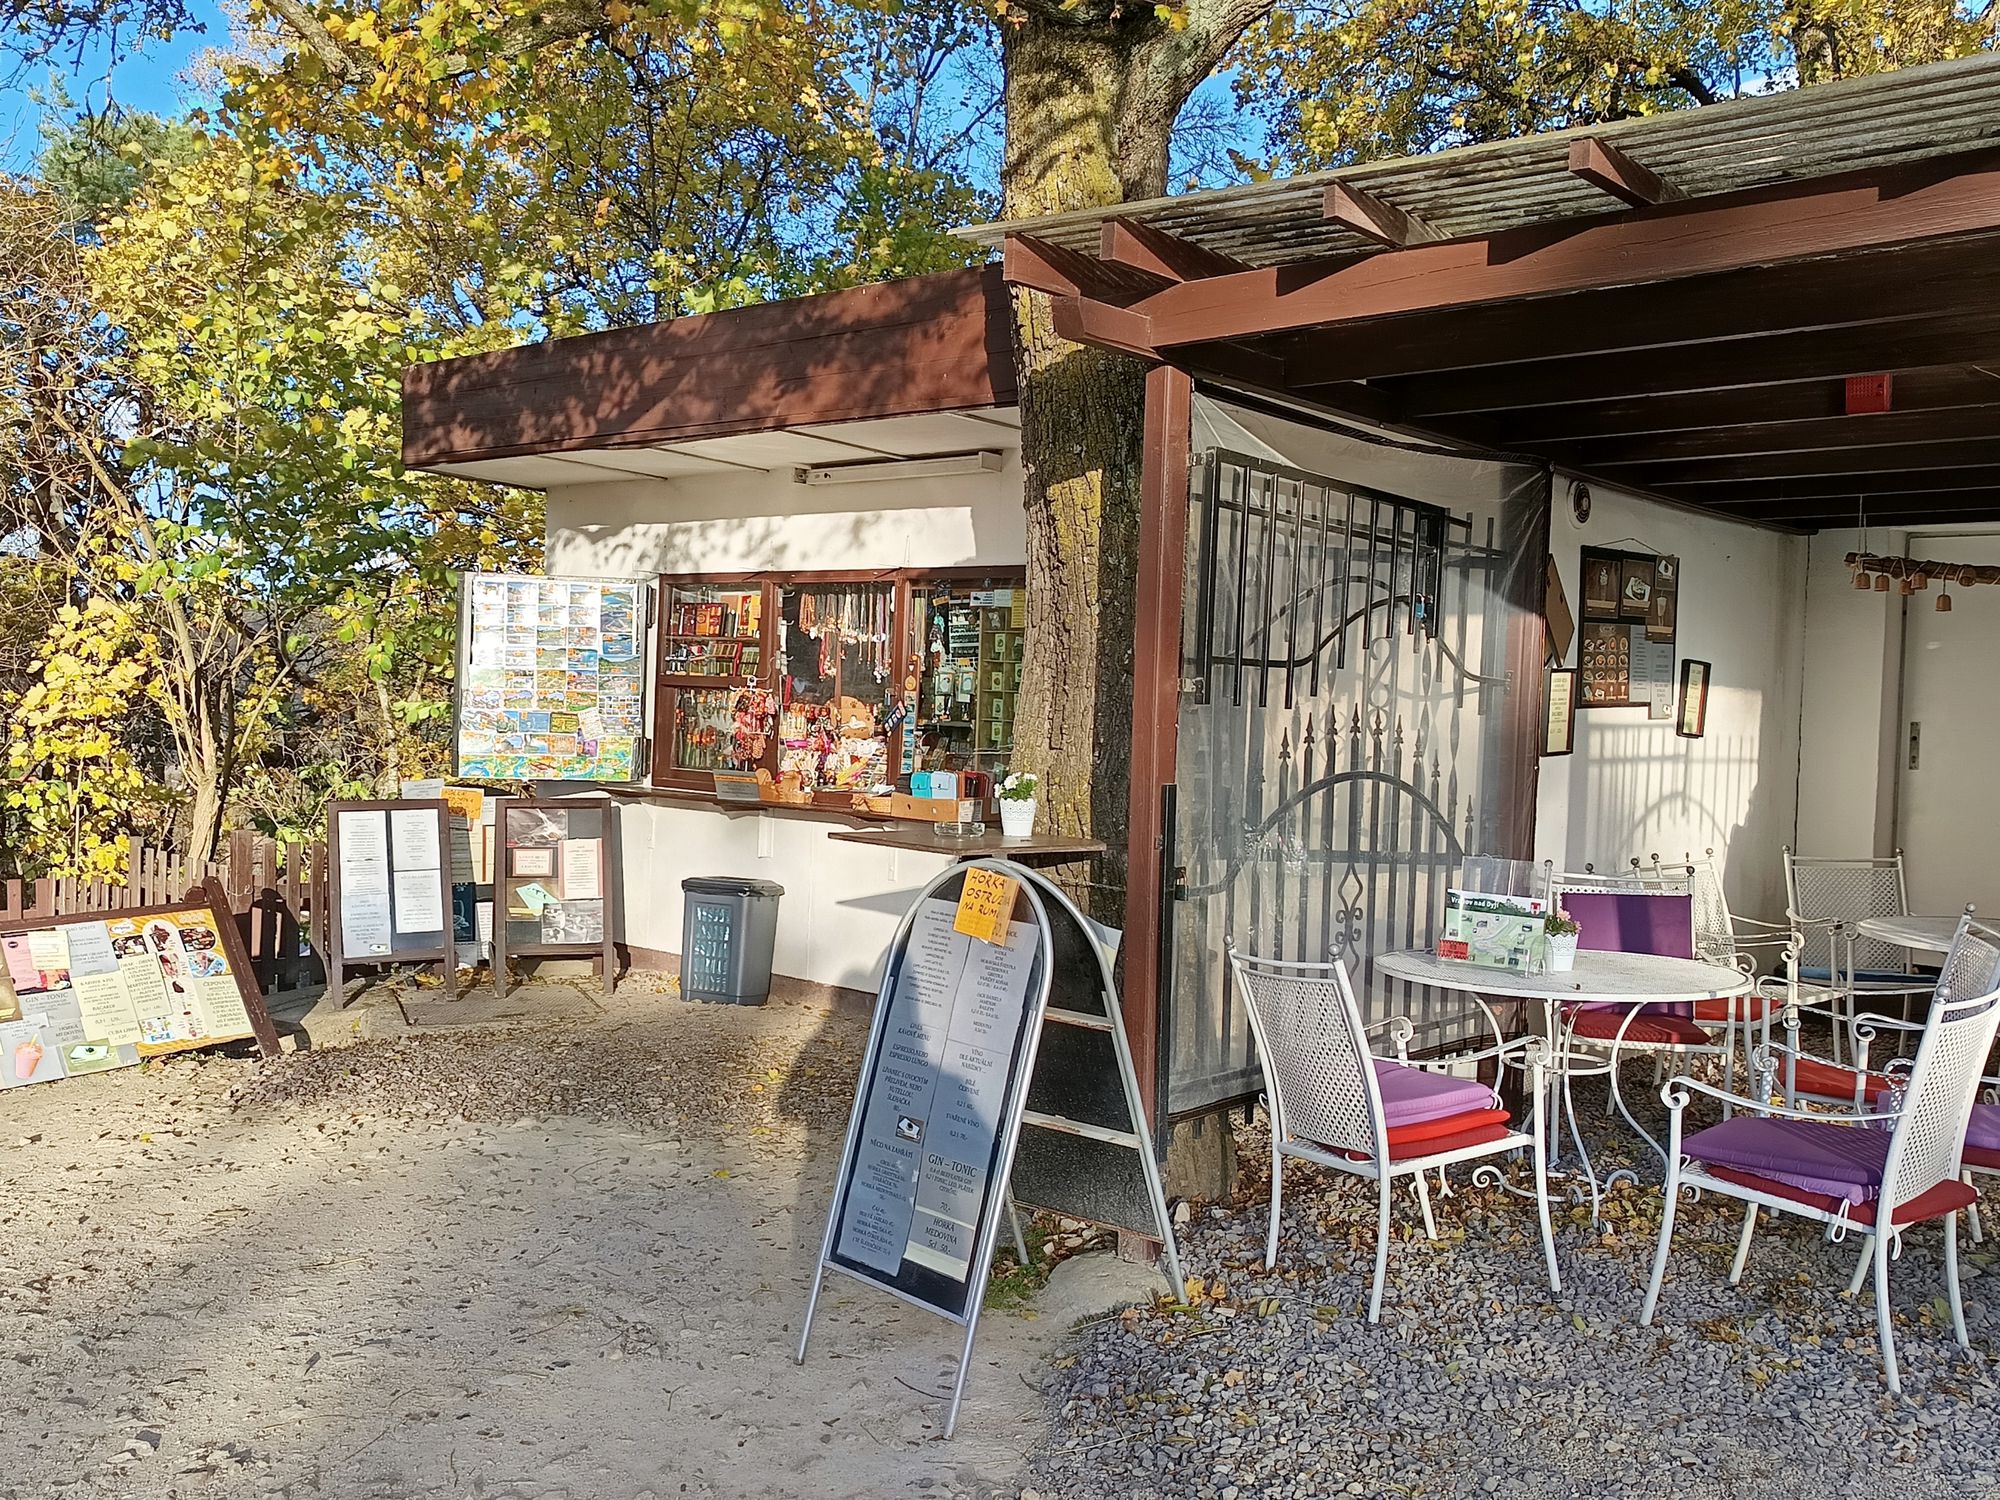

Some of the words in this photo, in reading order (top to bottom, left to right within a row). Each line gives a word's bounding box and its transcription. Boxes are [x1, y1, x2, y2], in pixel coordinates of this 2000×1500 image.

[962, 900, 975, 912] NA
[1474, 899, 1486, 908] nad
[25, 996, 40, 1004] GIN
[47, 992, 69, 1001] TONIC
[929, 1153, 944, 1165] GIN
[951, 1161, 977, 1177] TONIC
[933, 1217, 955, 1231] HORKÁ
[925, 1226, 958, 1244] MEDOVINA
